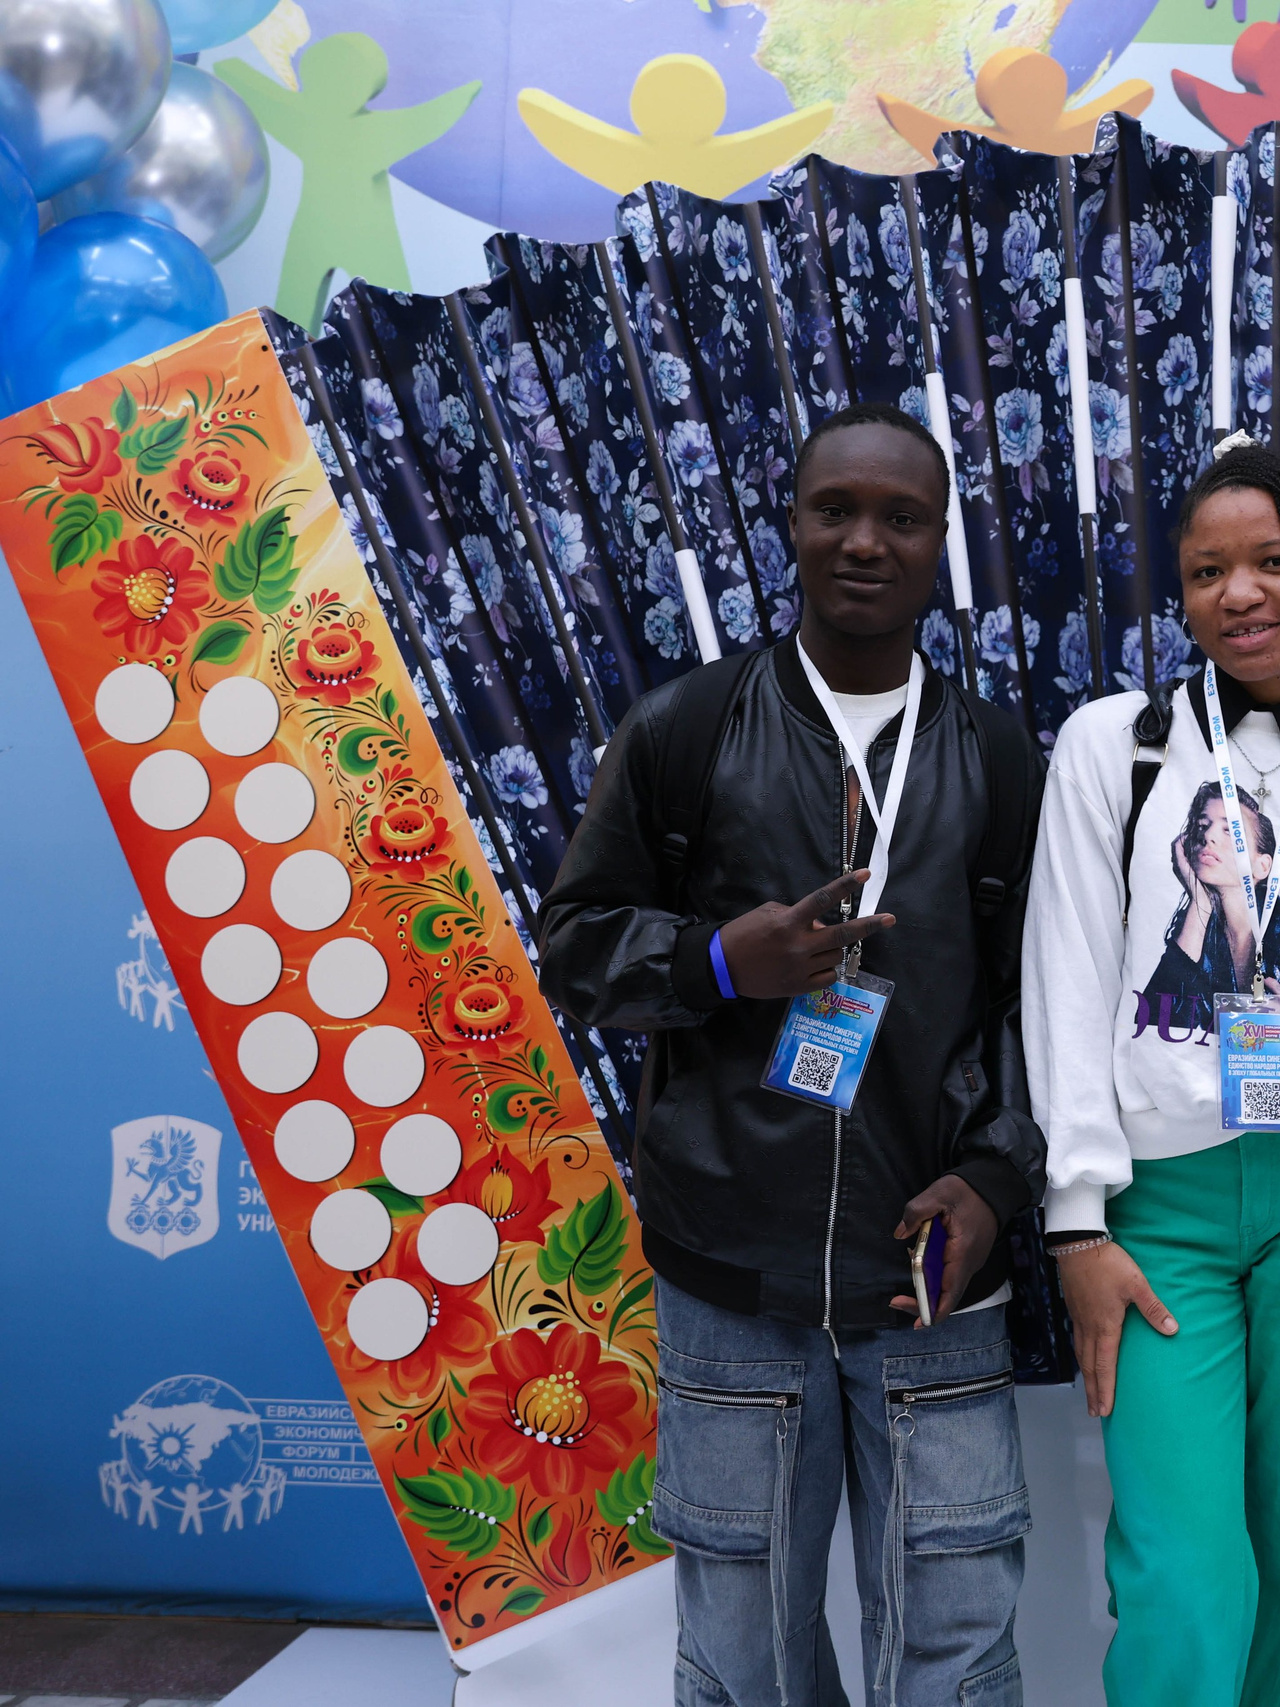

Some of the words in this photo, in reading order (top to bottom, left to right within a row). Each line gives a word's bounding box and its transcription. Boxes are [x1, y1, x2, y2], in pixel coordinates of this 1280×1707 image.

[1206, 668, 1215, 697] ЕЭФМ
[1212, 716, 1224, 745] ЕЭФМ
[1221, 766, 1234, 798] ЕЭФМ
[1231, 820, 1245, 853] ЕЭФМ
[1243, 875, 1254, 909] ЕЭФМ
[1265, 877, 1279, 910] ЕЭФМ
[1243, 1024, 1264, 1038] XVI
[237, 1213, 276, 1232] УНИ
[266, 1404, 356, 1420] ЕВРАЗИЙС
[274, 1426, 364, 1440] ЭКОНОМИЧ
[282, 1446, 340, 1459] ФОРУМ
[293, 1466, 380, 1481] МОЛОДЕЖ
